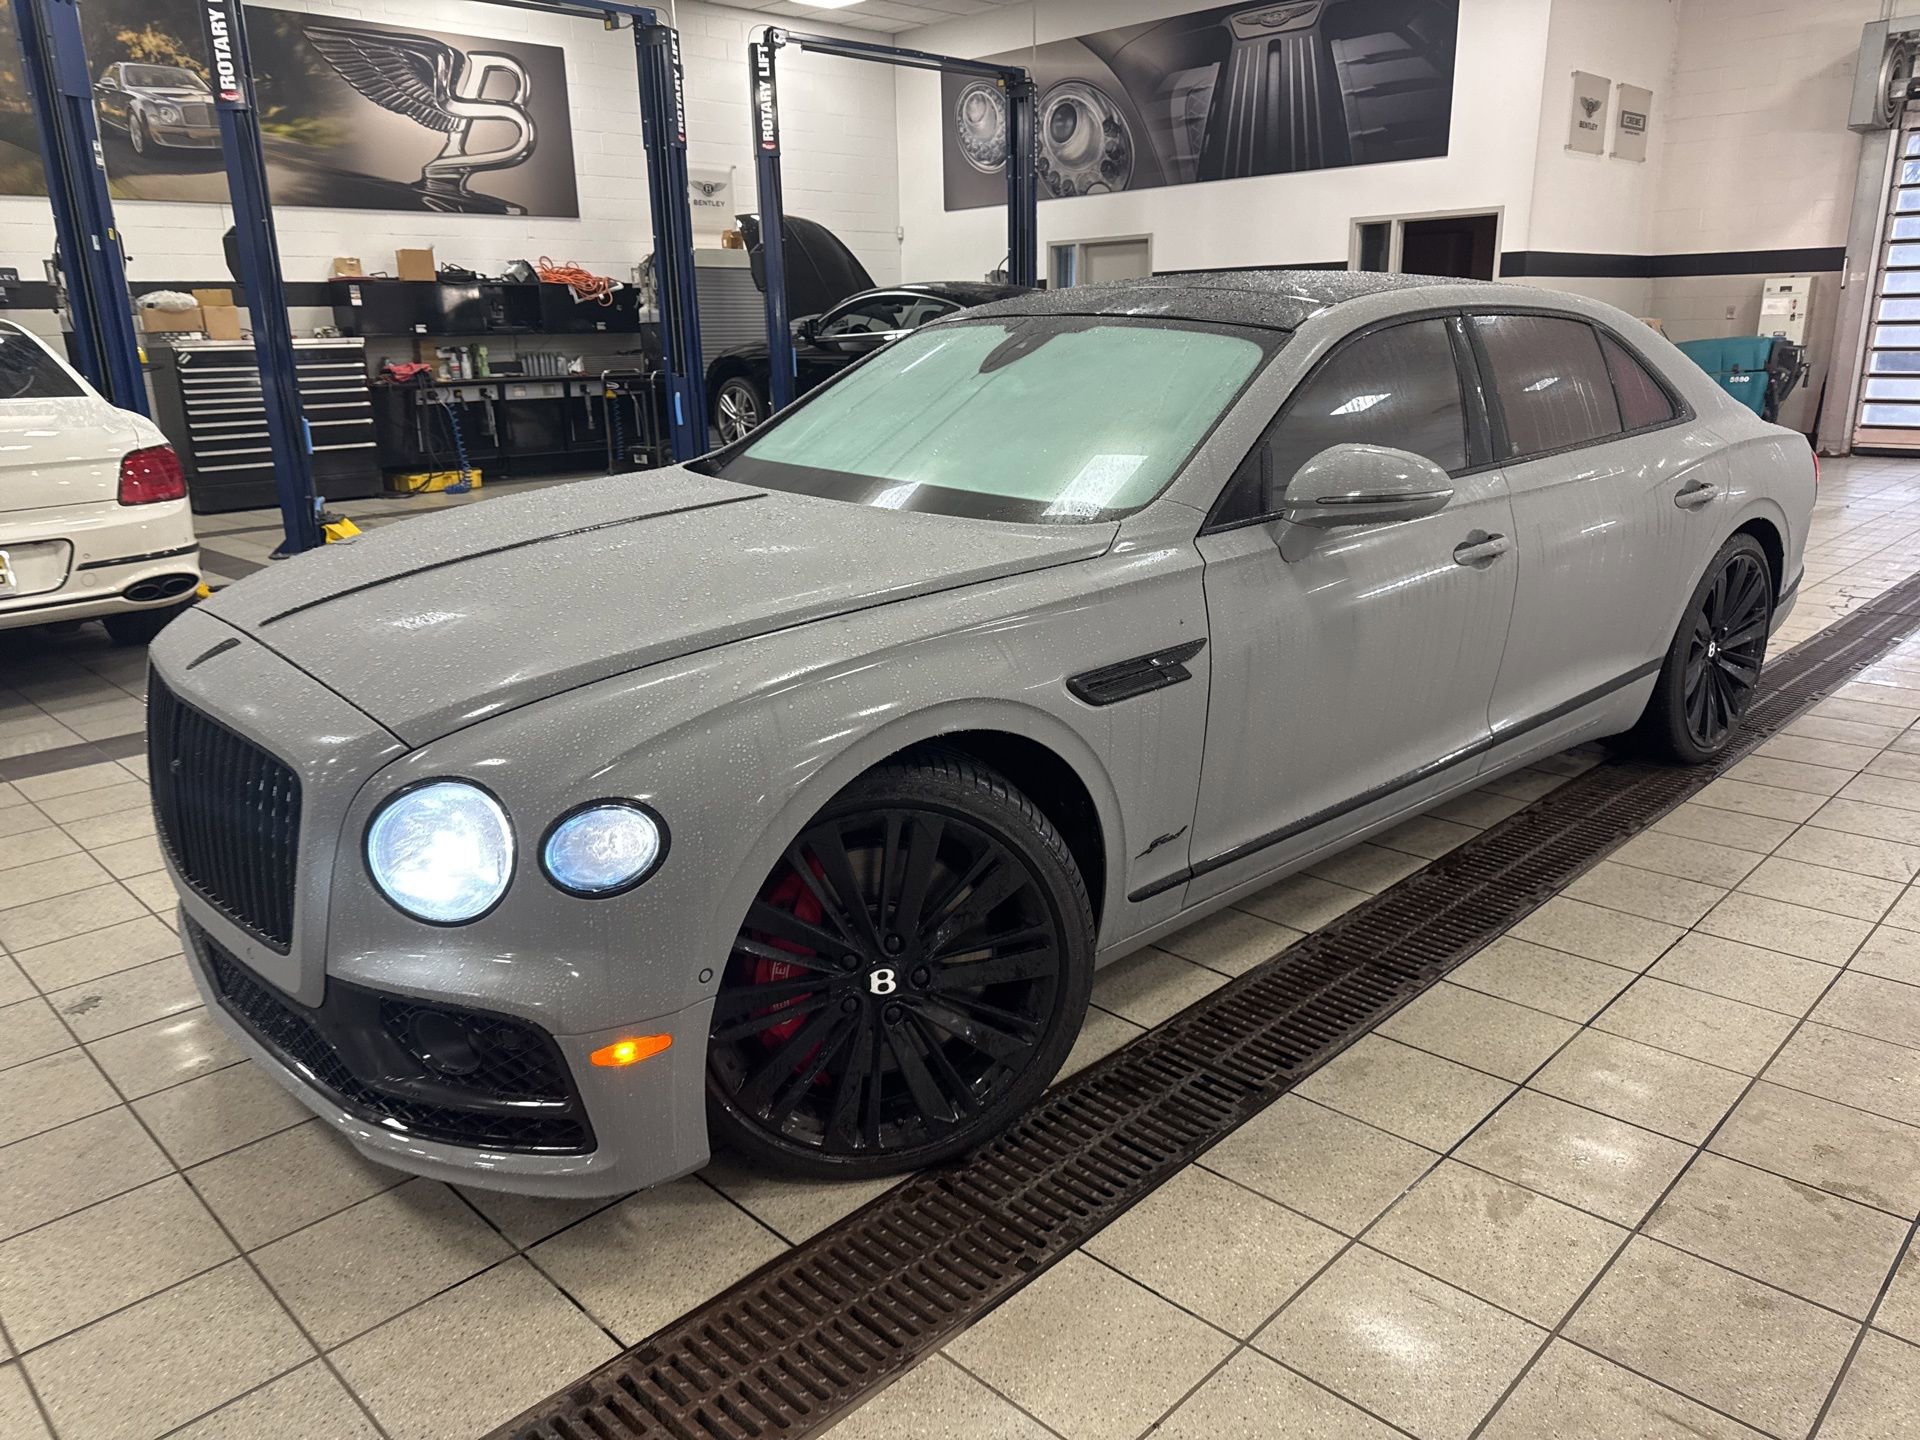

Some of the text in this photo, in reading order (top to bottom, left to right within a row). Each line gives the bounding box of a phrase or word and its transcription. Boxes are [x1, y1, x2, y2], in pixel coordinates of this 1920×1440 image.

[208, 8, 237, 90] ROTARY
[670, 30, 680, 65] LIFT
[757, 44, 770, 76] LIFT
[673, 69, 684, 133] ROTARY
[759, 80, 774, 141] ROTARY
[1579, 120, 1598, 130] BENTLEY
[693, 199, 725, 207] BENTLEY
[1708, 641, 1716, 657] B
[870, 969, 896, 994] B
